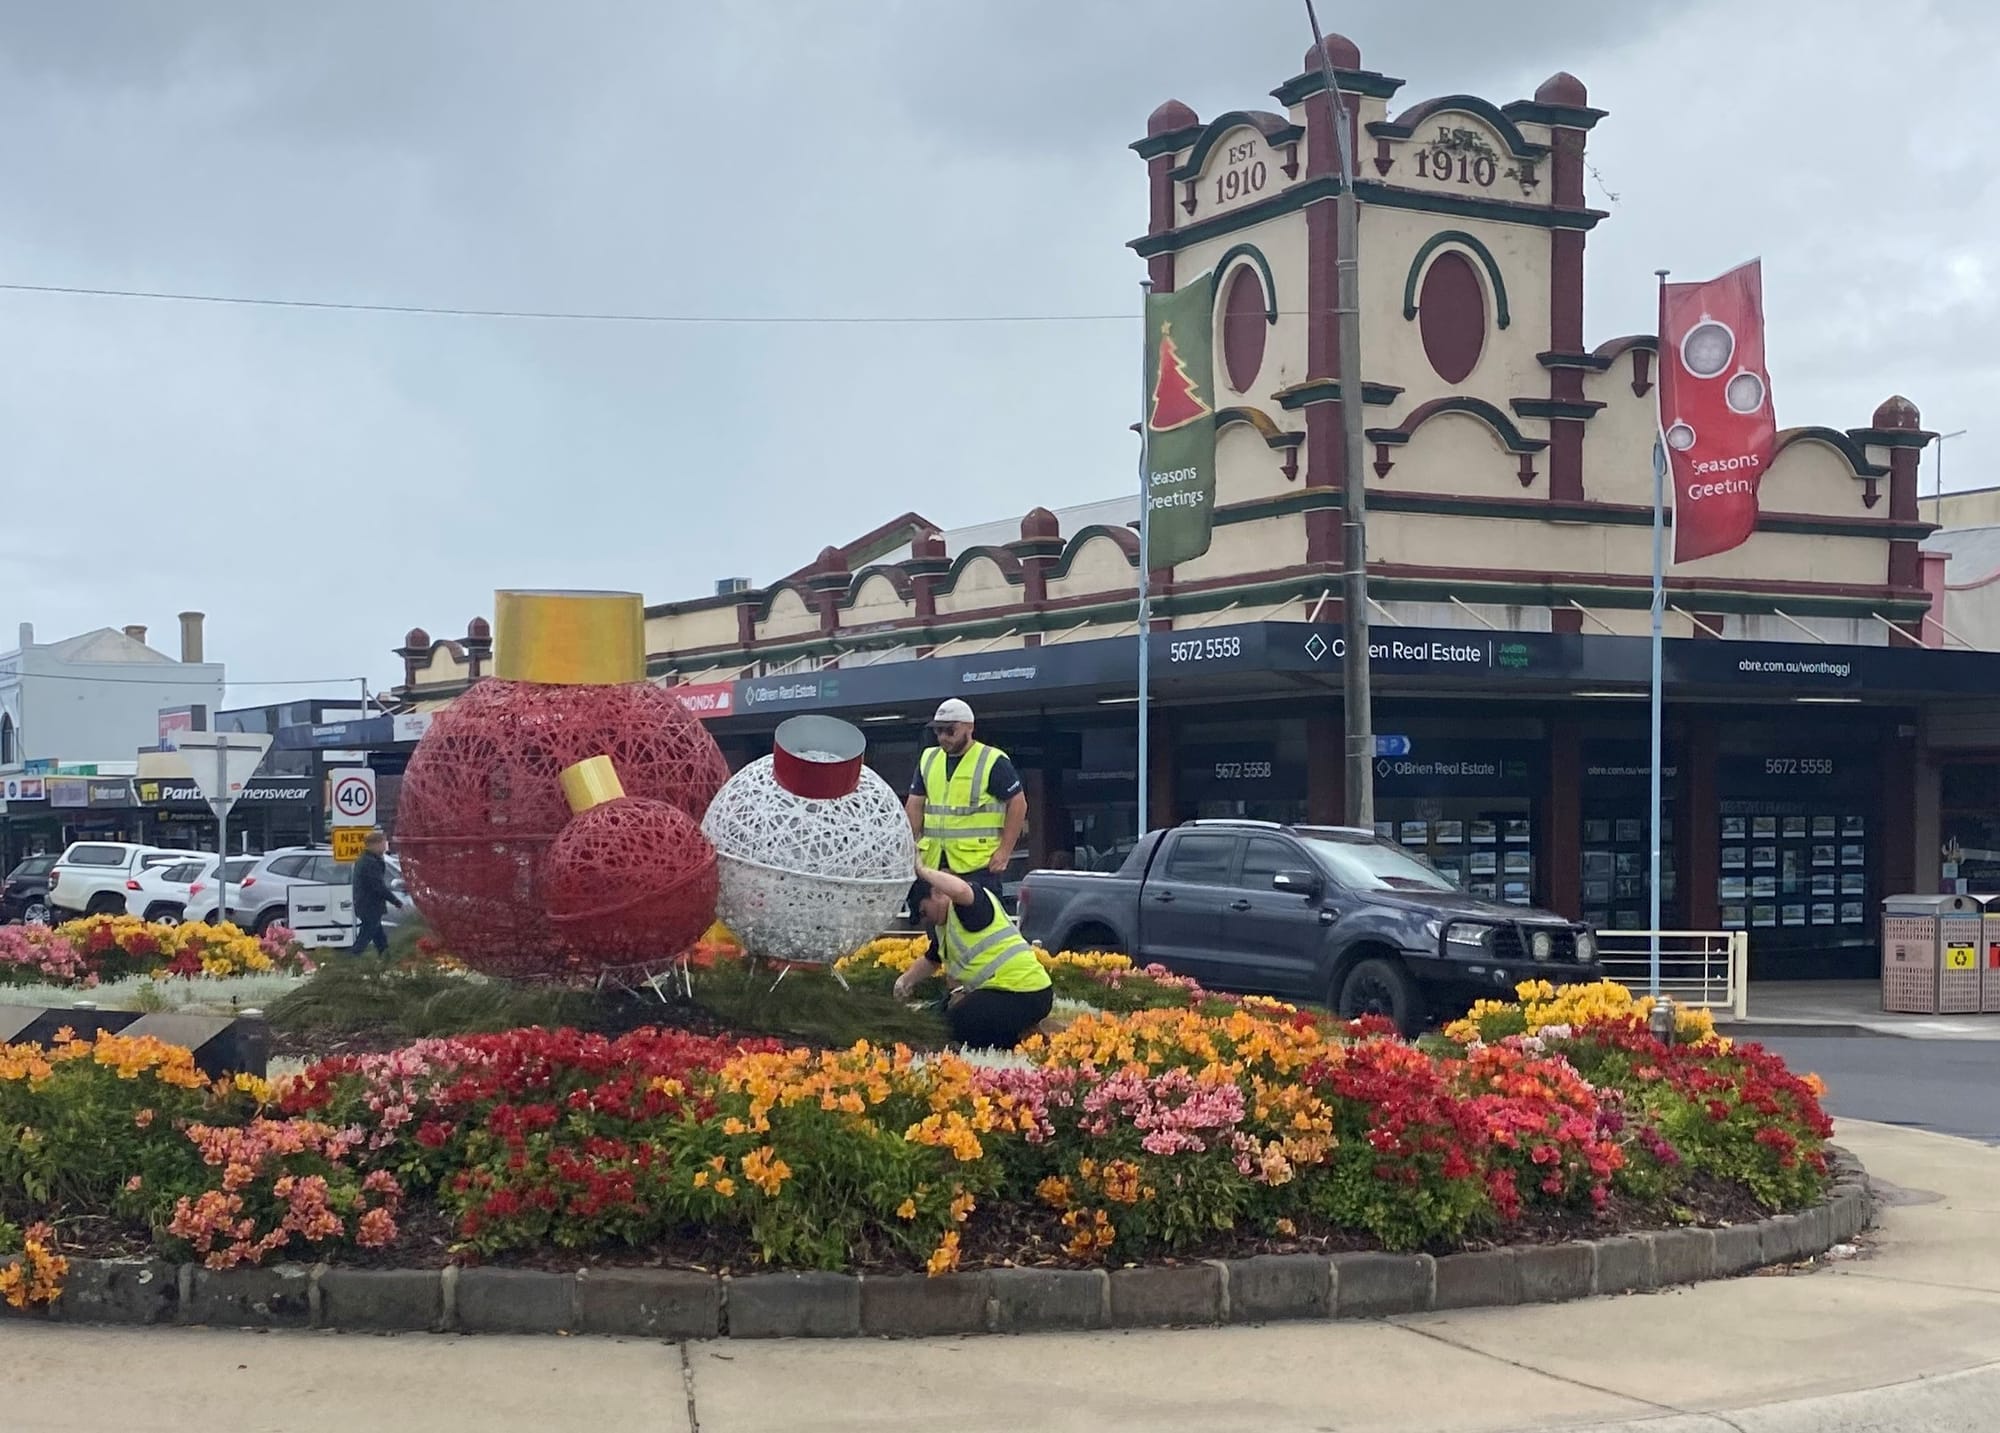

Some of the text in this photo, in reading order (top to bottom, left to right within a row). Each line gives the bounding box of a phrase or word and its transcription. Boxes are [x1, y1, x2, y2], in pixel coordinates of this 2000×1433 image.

[1228, 140, 1257, 165] EST
[1414, 148, 1496, 187] 1910
[1216, 161, 1267, 205] 1910
[1691, 453, 1760, 476] Seasons
[1170, 636, 1241, 663] 5672 5558
[1332, 639, 1481, 662] Oen Real Estate
[1738, 659, 1851, 677] obre.com.au/wonthaggi
[1215, 761, 1272, 779] 5672 5558
[1435, 762, 1460, 774] Real
[1461, 762, 1495, 775] Estate
[1765, 759, 1833, 775] 5672 5558
[340, 787, 368, 807] 40
